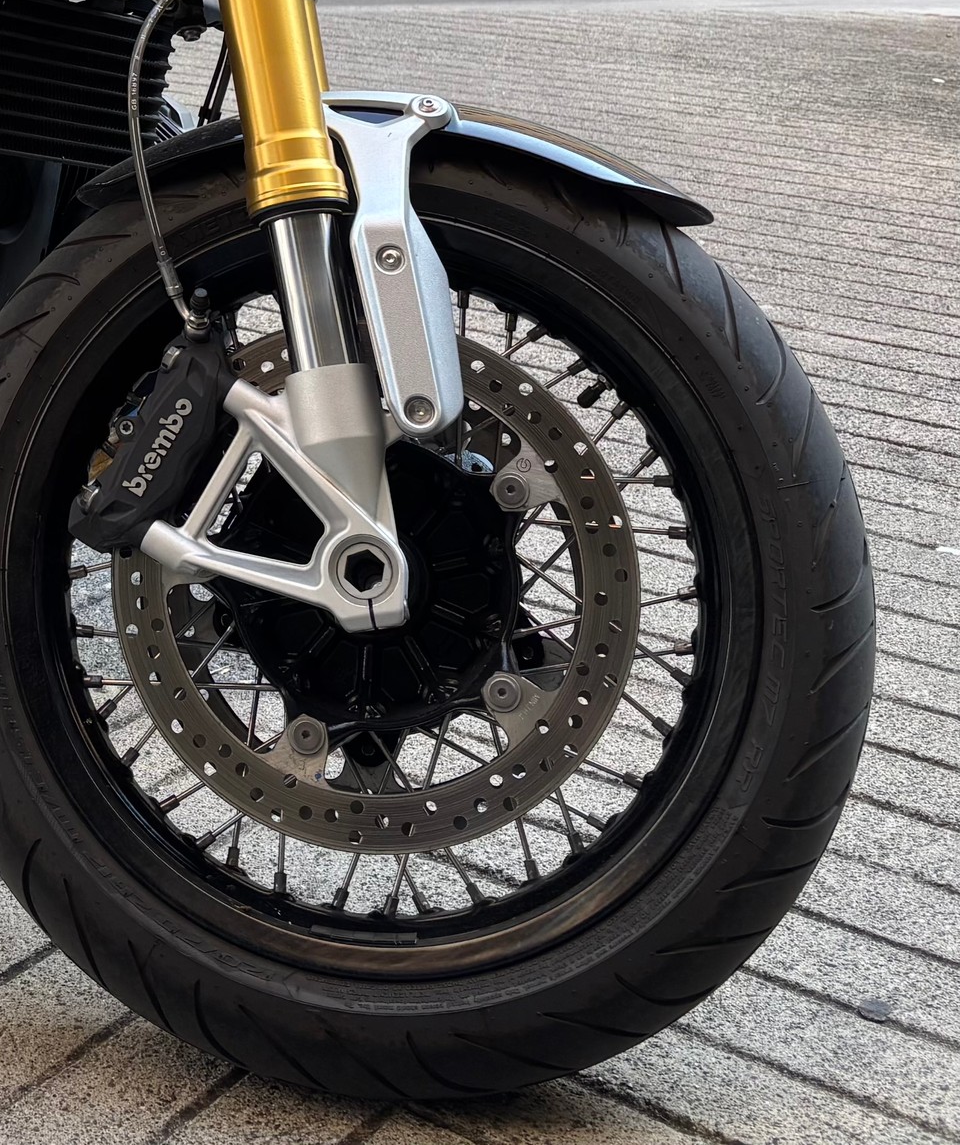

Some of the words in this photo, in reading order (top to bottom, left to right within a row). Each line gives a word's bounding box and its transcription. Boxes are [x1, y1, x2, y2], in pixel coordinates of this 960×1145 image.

[130, 98, 138, 111] GB
[122, 398, 192, 497] brembo
[758, 495, 789, 670] SPORTEC
